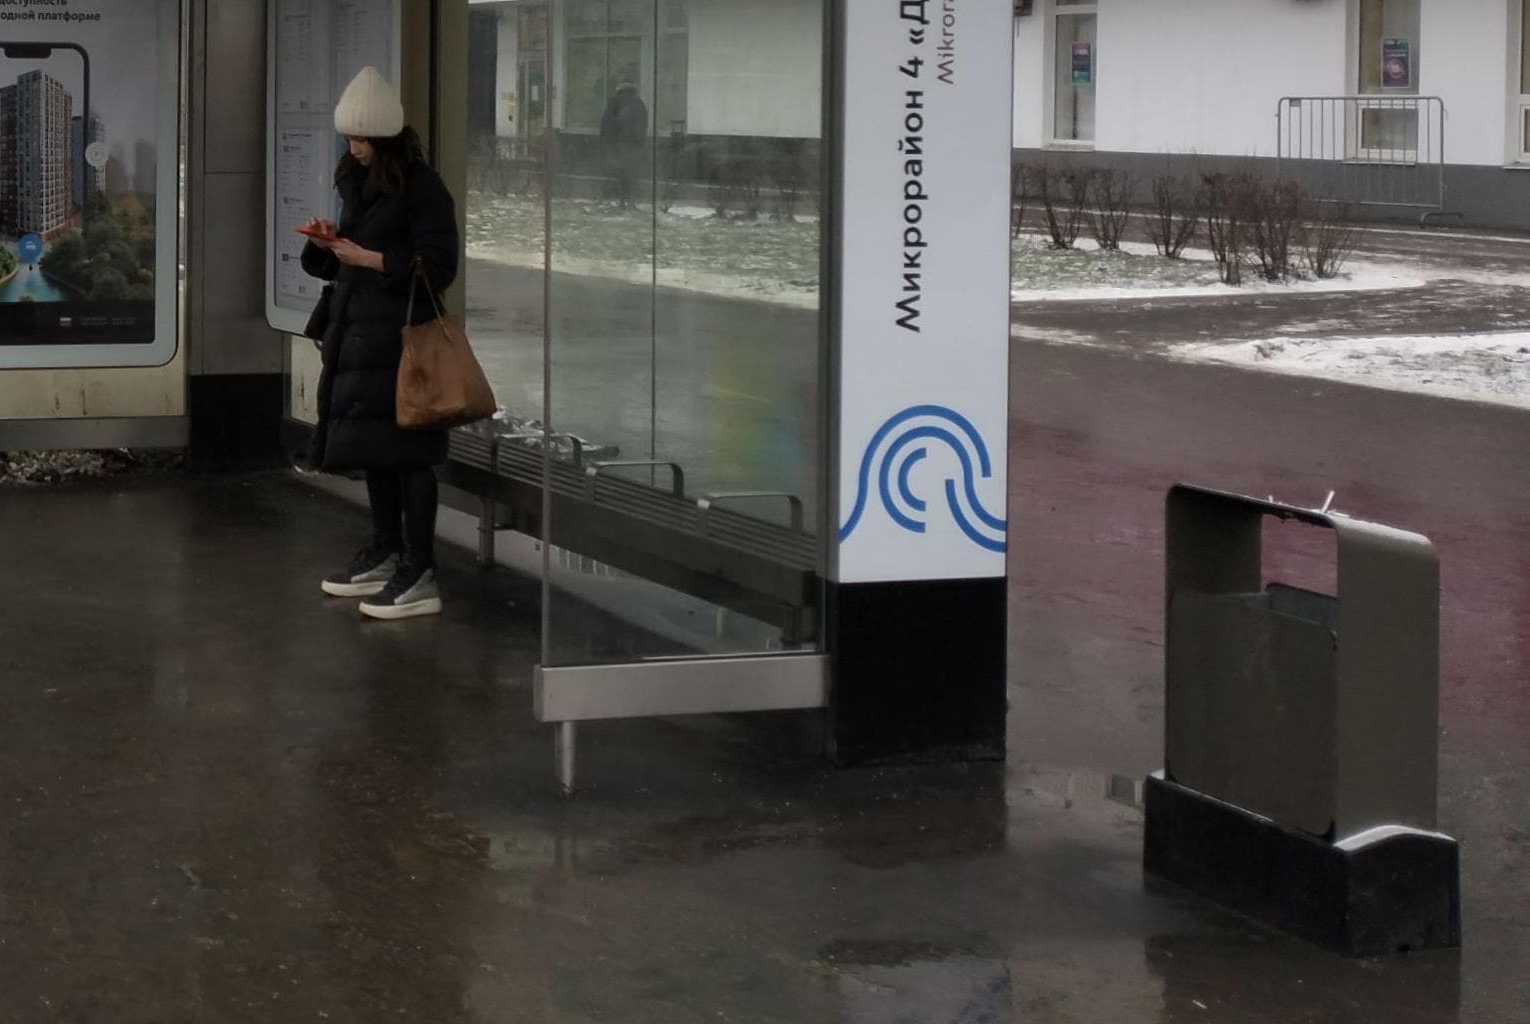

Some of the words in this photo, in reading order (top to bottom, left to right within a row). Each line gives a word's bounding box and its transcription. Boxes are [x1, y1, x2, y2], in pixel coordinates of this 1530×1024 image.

[0, 10, 36, 22] одной
[37, 10, 102, 23] платформе
[898, 55, 924, 79] 4
[895, 90, 929, 333] Микрорайон
